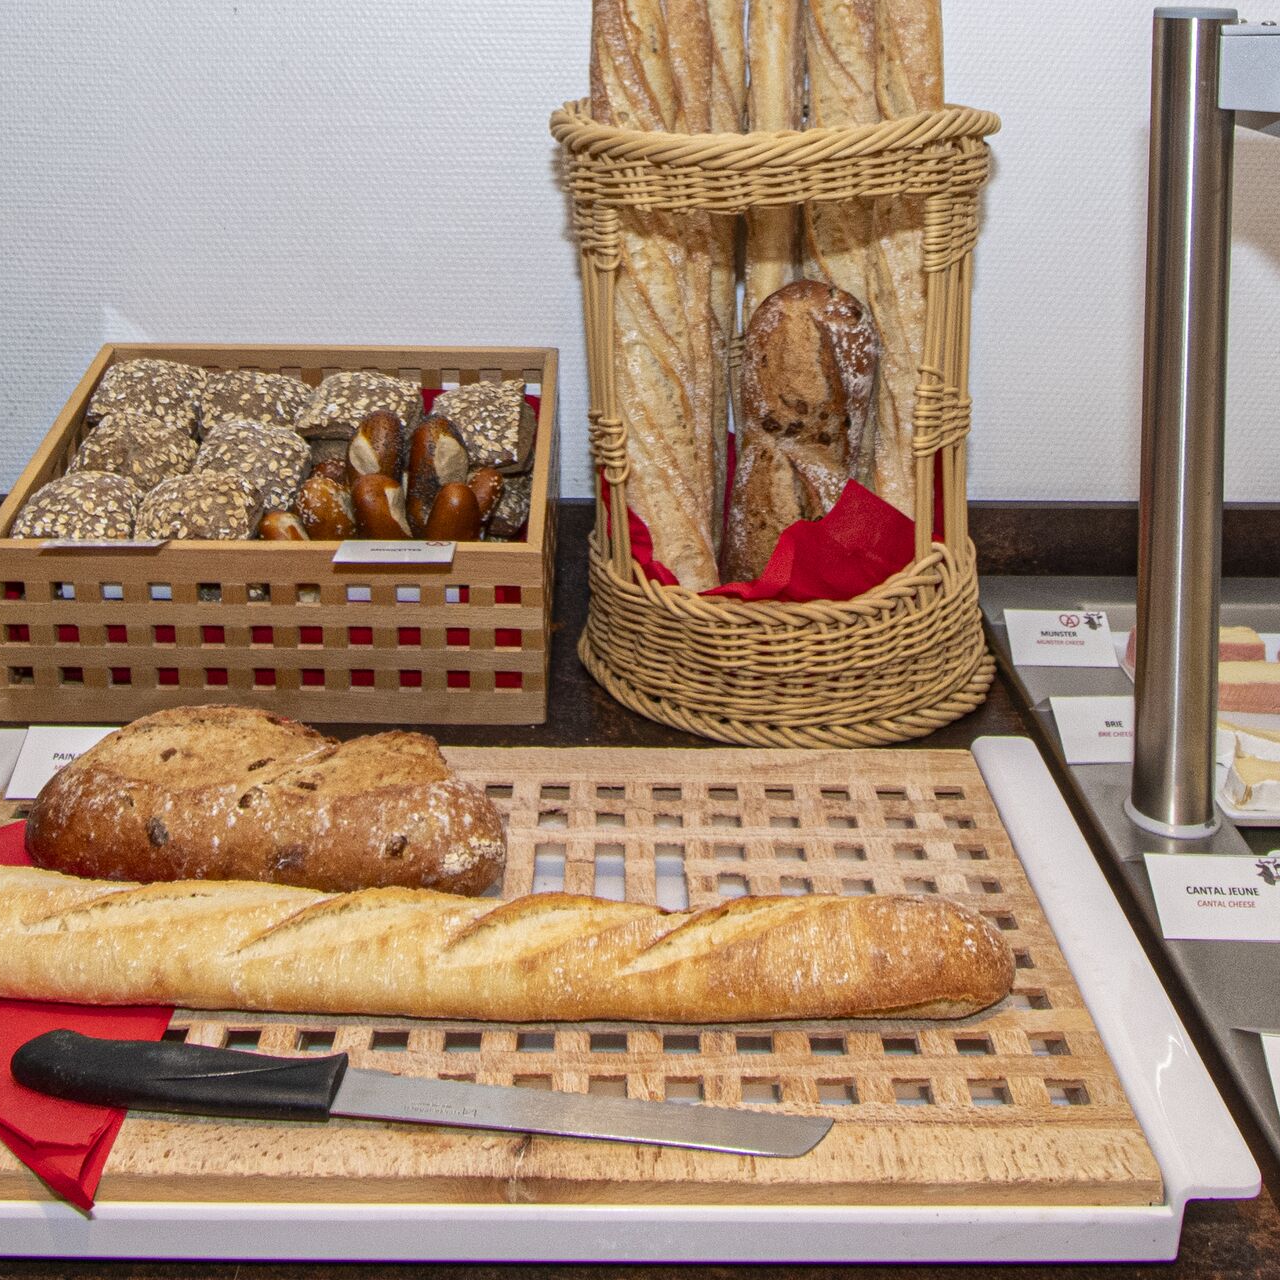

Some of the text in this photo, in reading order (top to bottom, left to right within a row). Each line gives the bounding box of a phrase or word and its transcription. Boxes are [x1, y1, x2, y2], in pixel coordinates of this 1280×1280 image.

[1040, 630, 1078, 638] MUNSTER
[1104, 720, 1124, 728] BRIE
[52, 752, 75, 761] PAIN
[1186, 885, 1260, 897] CANTAL JEUNE
[1197, 900, 1227, 908] CANTAL
